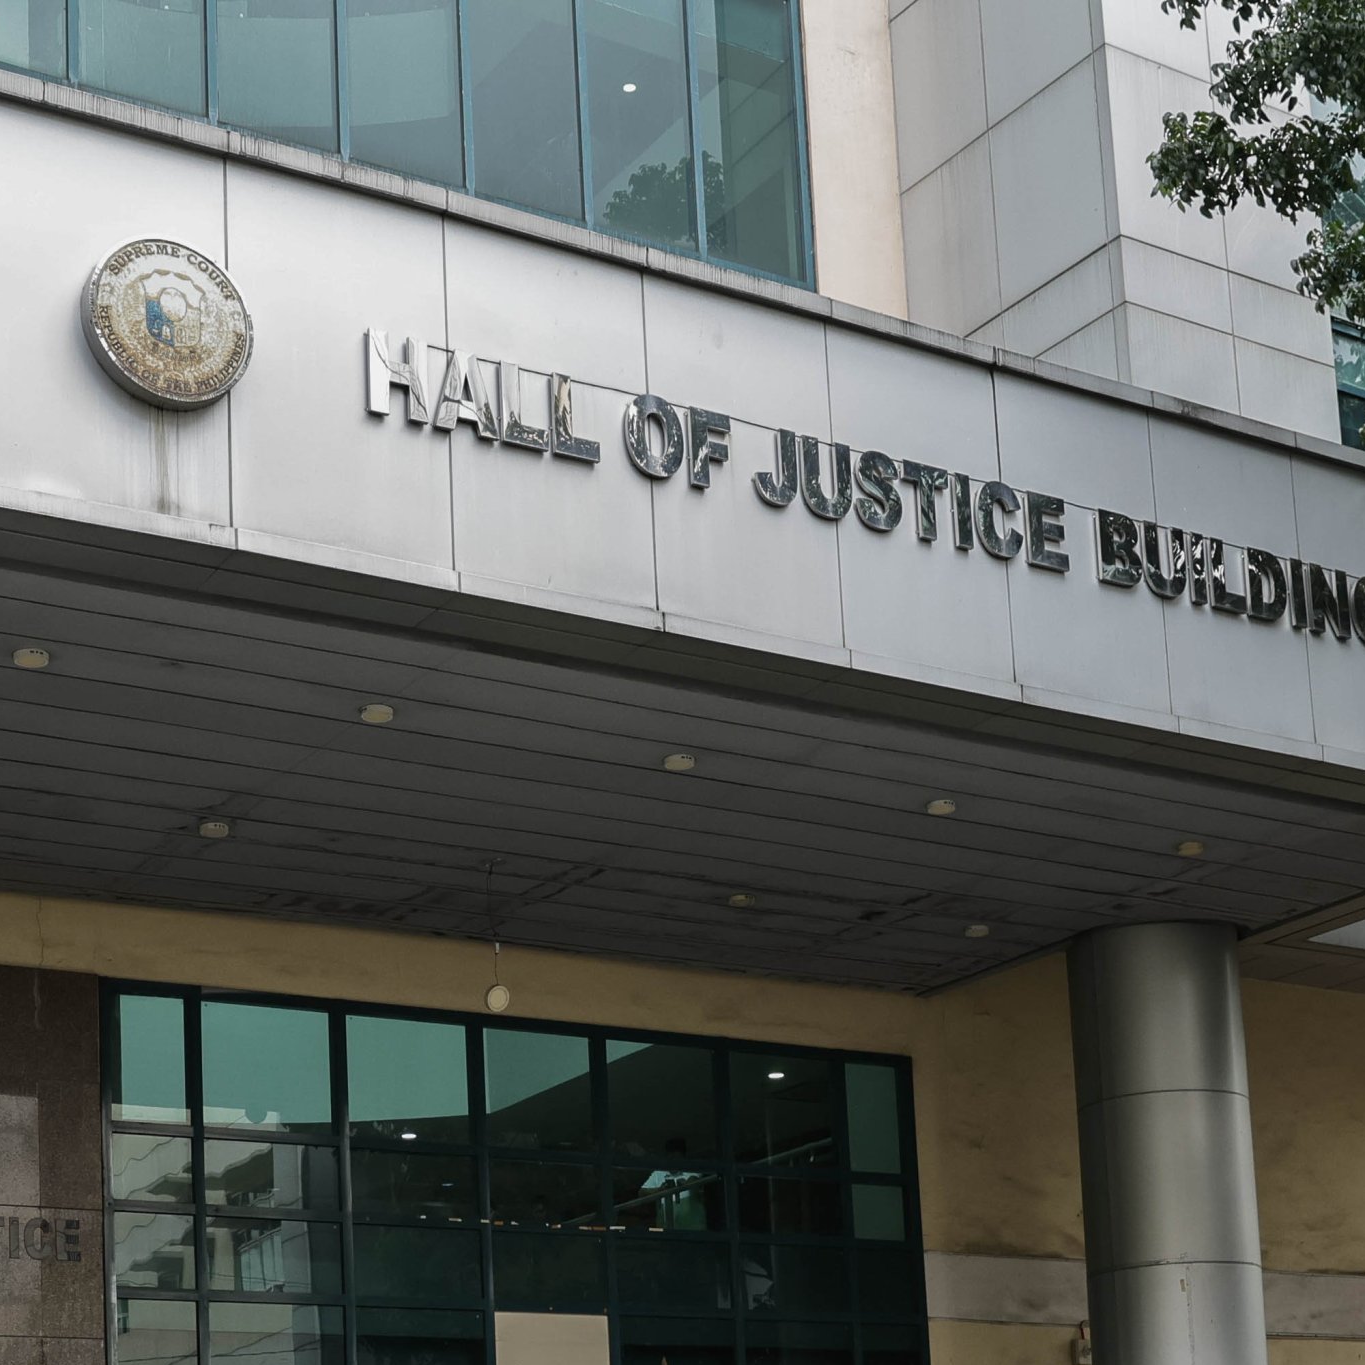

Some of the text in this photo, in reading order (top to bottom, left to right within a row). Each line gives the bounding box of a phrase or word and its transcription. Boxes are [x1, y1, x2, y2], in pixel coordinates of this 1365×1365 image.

[109, 243, 237, 302] SUPREME COURT
[99, 304, 137, 369] REPUBLIC
[195, 333, 245, 391] PHILIPPINES
[363, 327, 601, 464] HALL
[623, 393, 731, 490] OF
[751, 427, 1071, 574] JUSTICE
